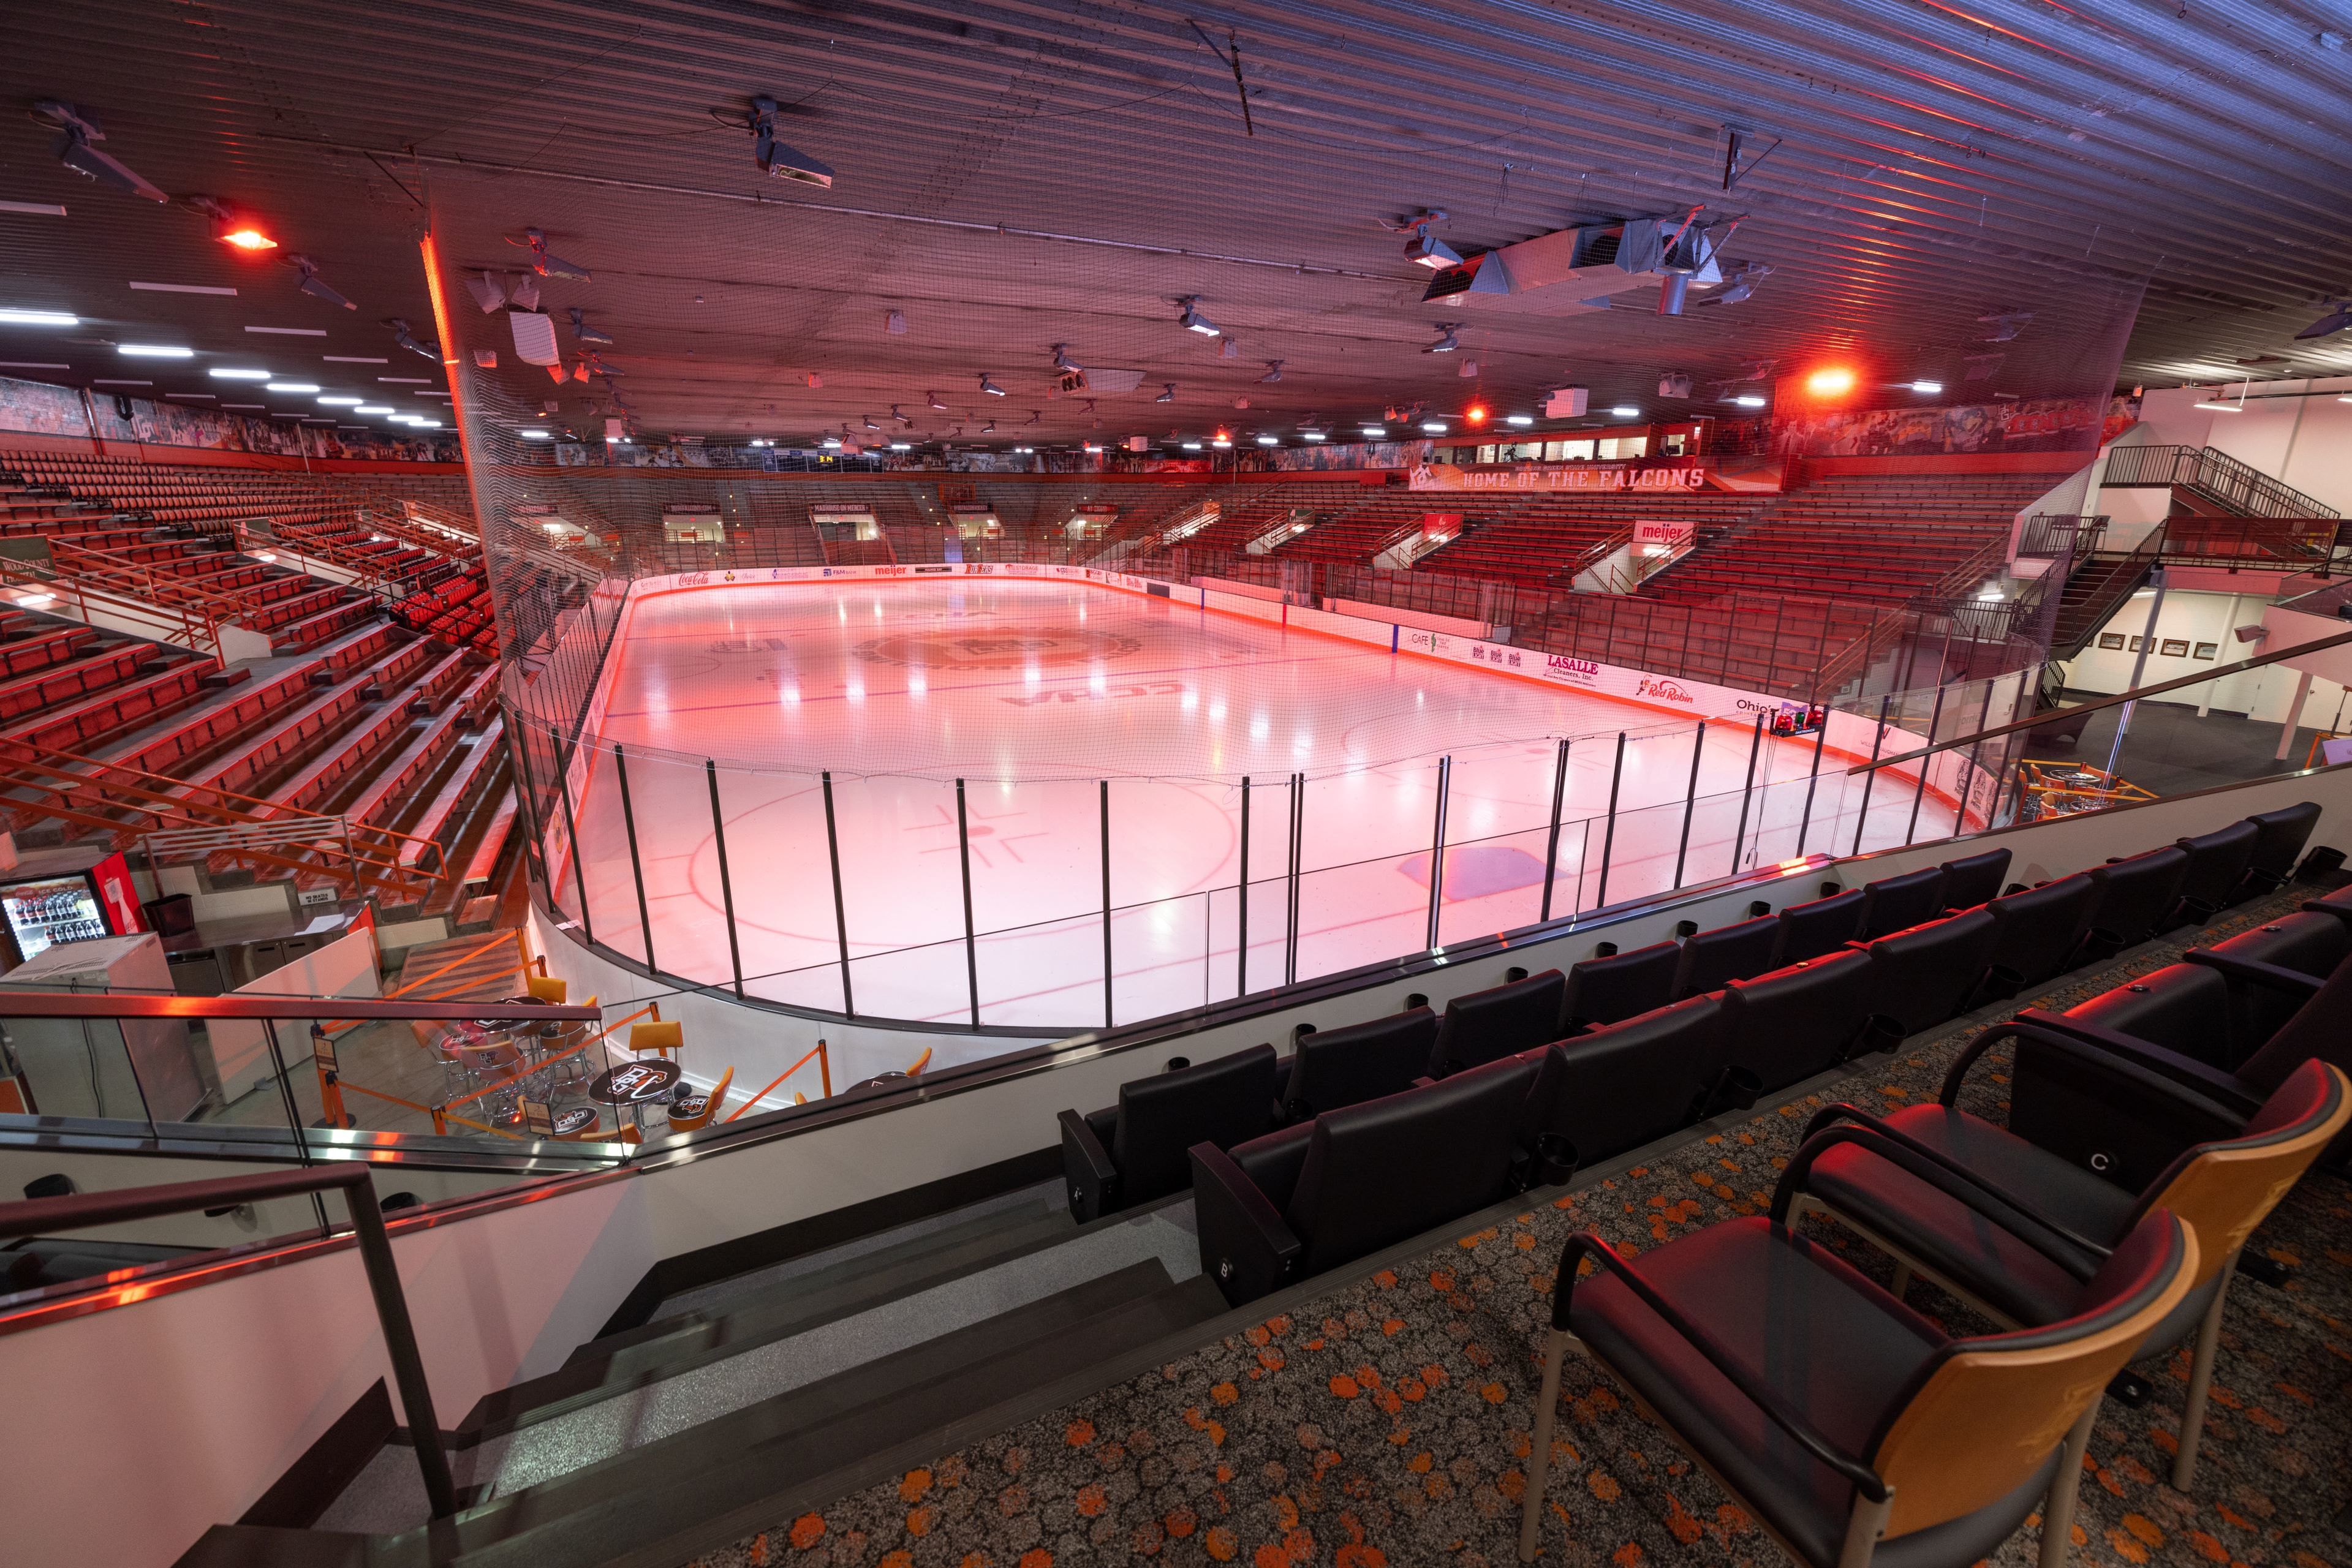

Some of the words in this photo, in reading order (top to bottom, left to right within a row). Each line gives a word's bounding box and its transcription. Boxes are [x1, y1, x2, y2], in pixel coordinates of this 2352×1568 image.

[1463, 472, 1510, 488] HOME
[1517, 471, 1540, 488] OF
[1548, 470, 1589, 488] THE
[1598, 468, 1704, 488] FALCONS
[1642, 523, 1684, 543] meijer
[875, 565, 907, 576] meijer
[678, 571, 710, 587] Coca-Cola
[1412, 633, 1429, 646] CAFE
[1548, 655, 1598, 675] LASALLE
[1553, 668, 1581, 679] Cleaners,
[1582, 673, 1594, 681] Inc.
[1648, 684, 1665, 698] Red
[1666, 687, 1694, 704] Robin
[1860, 740, 1875, 748] WILLIA
[2090, 1153, 2109, 1170] C
[1221, 1262, 1228, 1278] B
